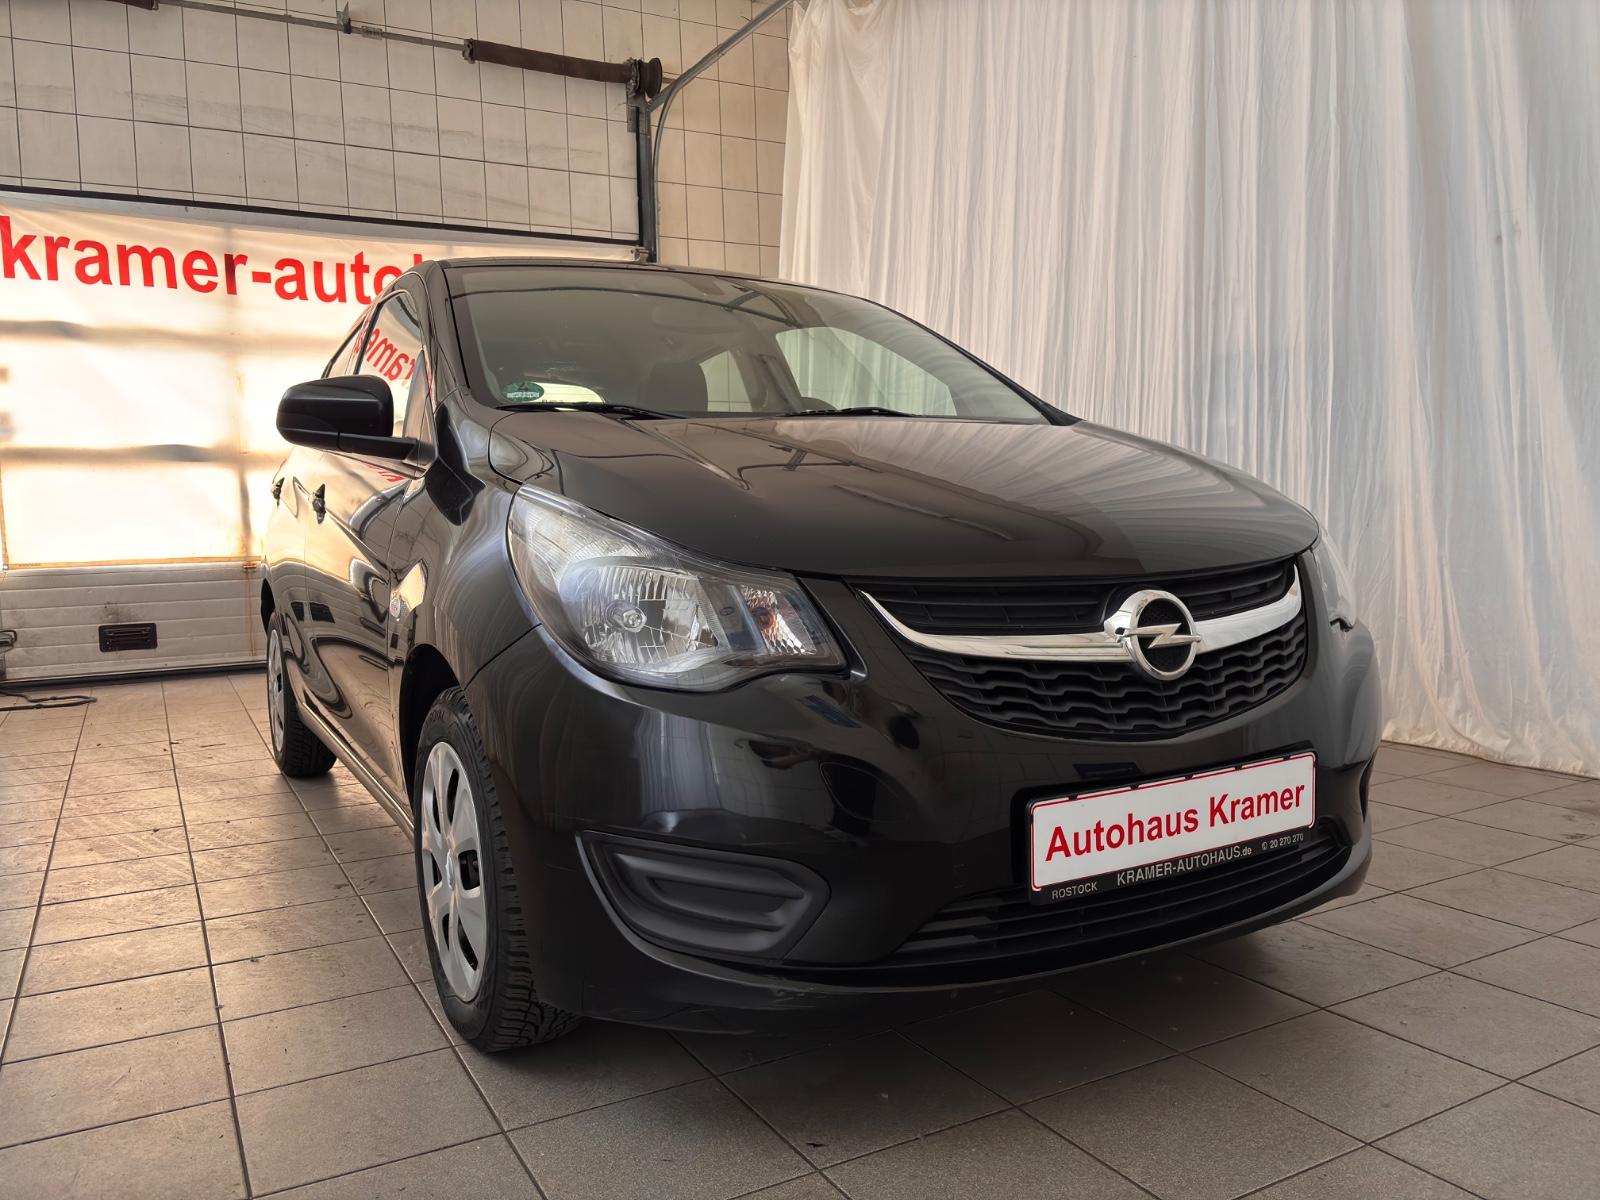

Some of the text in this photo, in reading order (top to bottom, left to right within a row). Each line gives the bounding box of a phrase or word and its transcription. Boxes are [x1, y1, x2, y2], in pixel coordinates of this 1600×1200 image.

[0, 215, 423, 305] kramer-auto
[1045, 784, 1305, 861] Autohaus Kramer
[1051, 881, 1098, 900] ROSTOCK
[1117, 845, 1252, 886] KRAMER-AUTOHAUS.de
